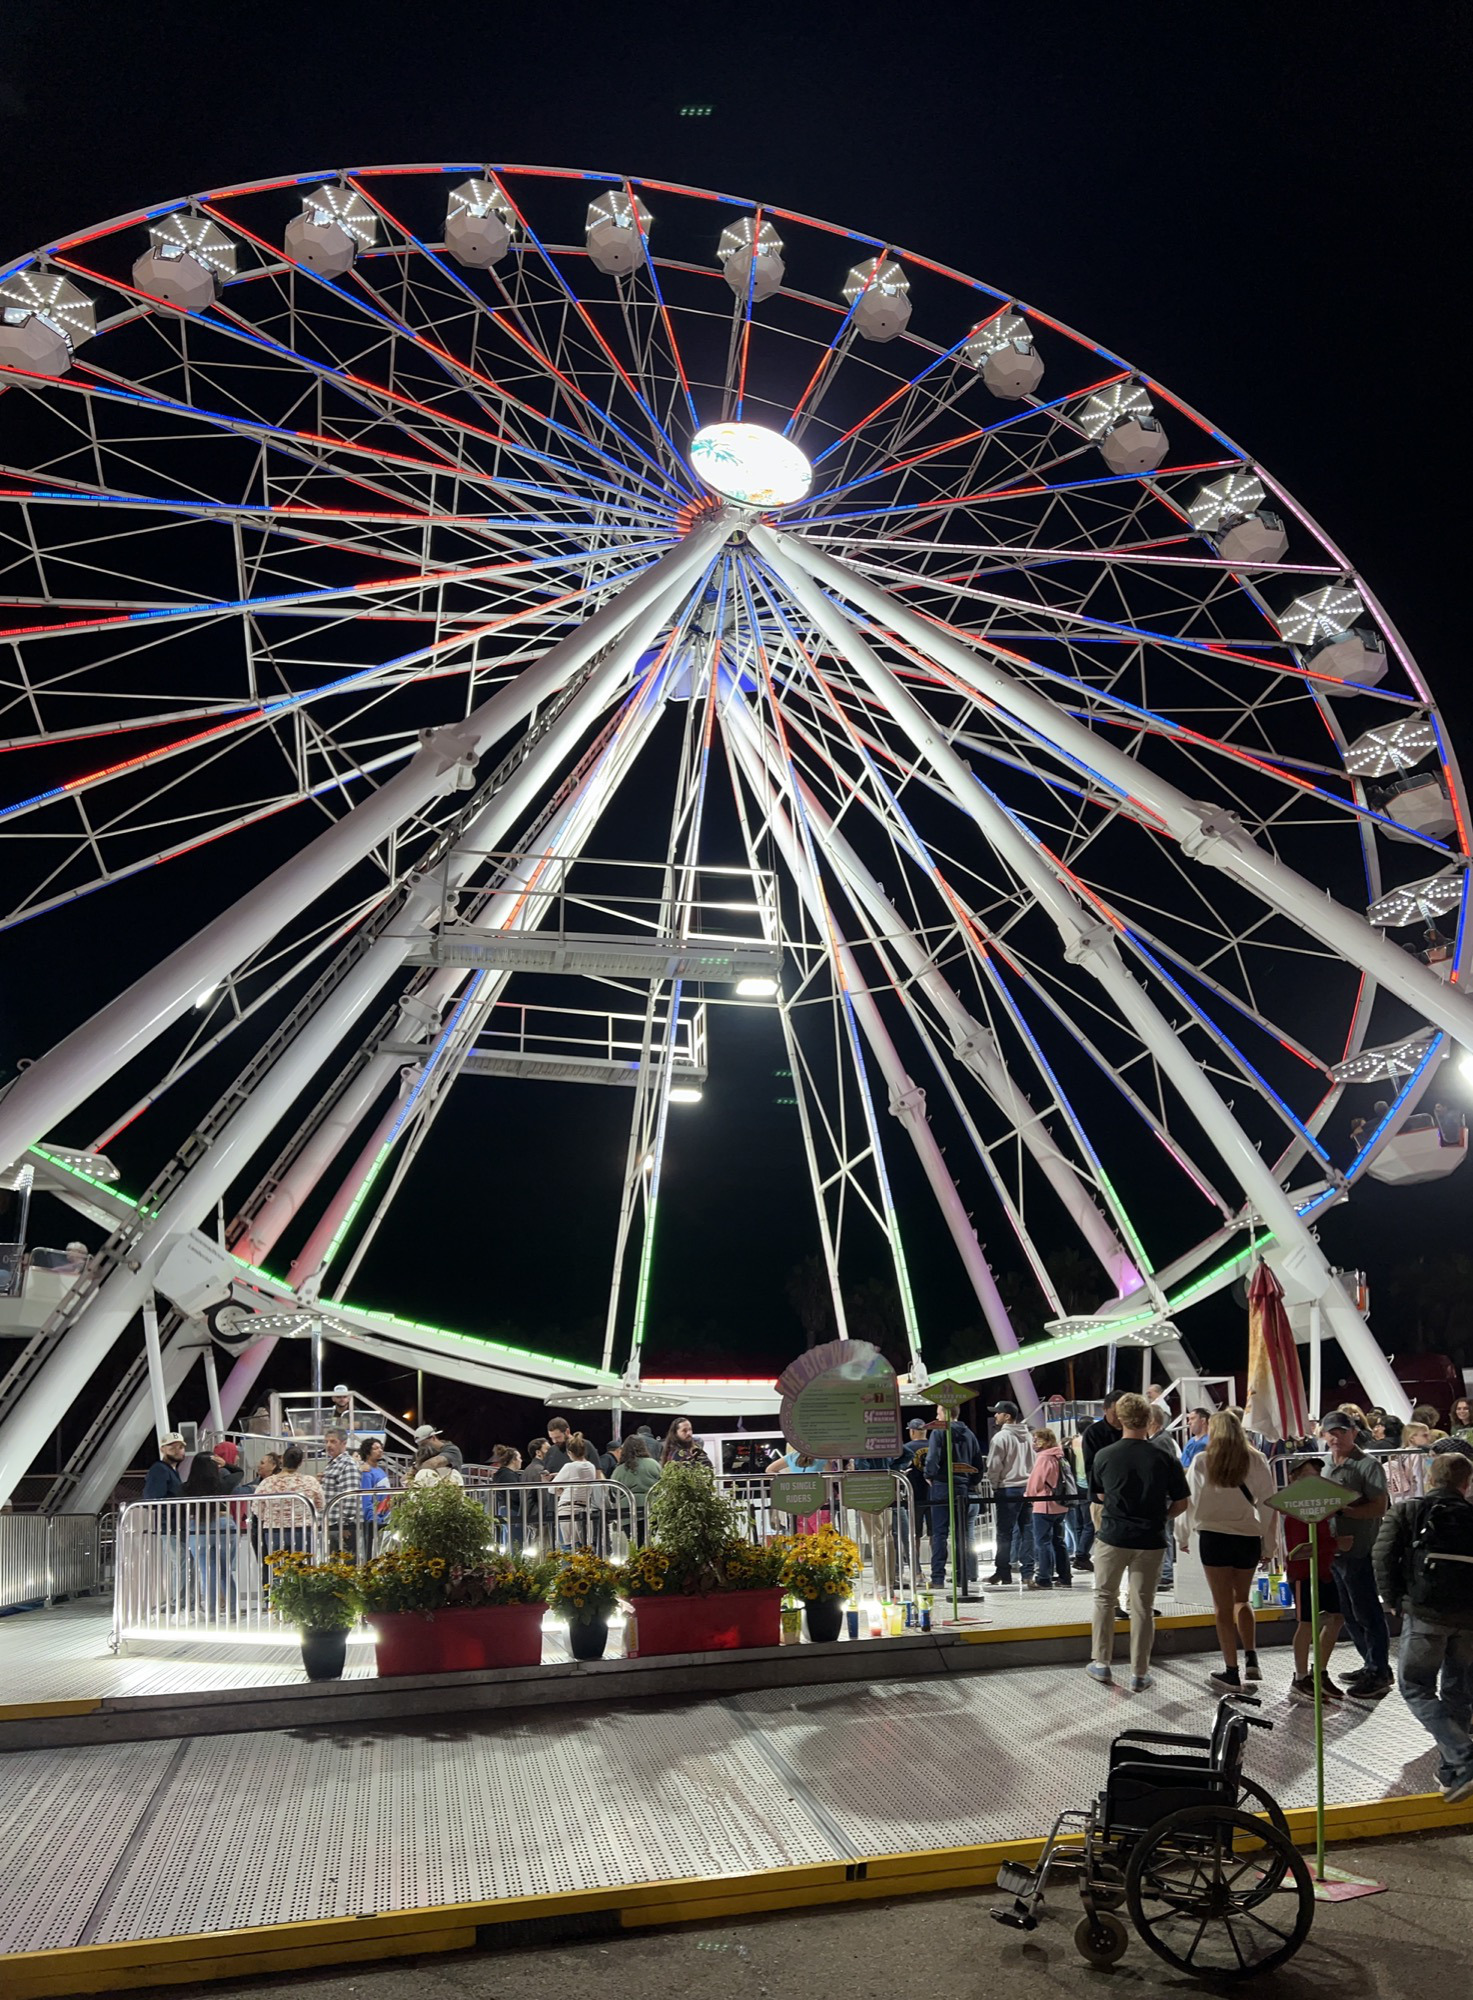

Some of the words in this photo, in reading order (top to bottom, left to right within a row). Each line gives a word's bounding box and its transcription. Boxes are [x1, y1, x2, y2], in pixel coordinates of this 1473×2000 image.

[798, 1346, 828, 1380] BIG
[780, 1482, 790, 1490] NO
[792, 1481, 817, 1490] SINGLE
[786, 1494, 812, 1503] RIDERS
[1284, 1499, 1321, 1508] TICKETS
[1323, 1498, 1341, 1506] PER
[1300, 1506, 1326, 1515] RIDER
